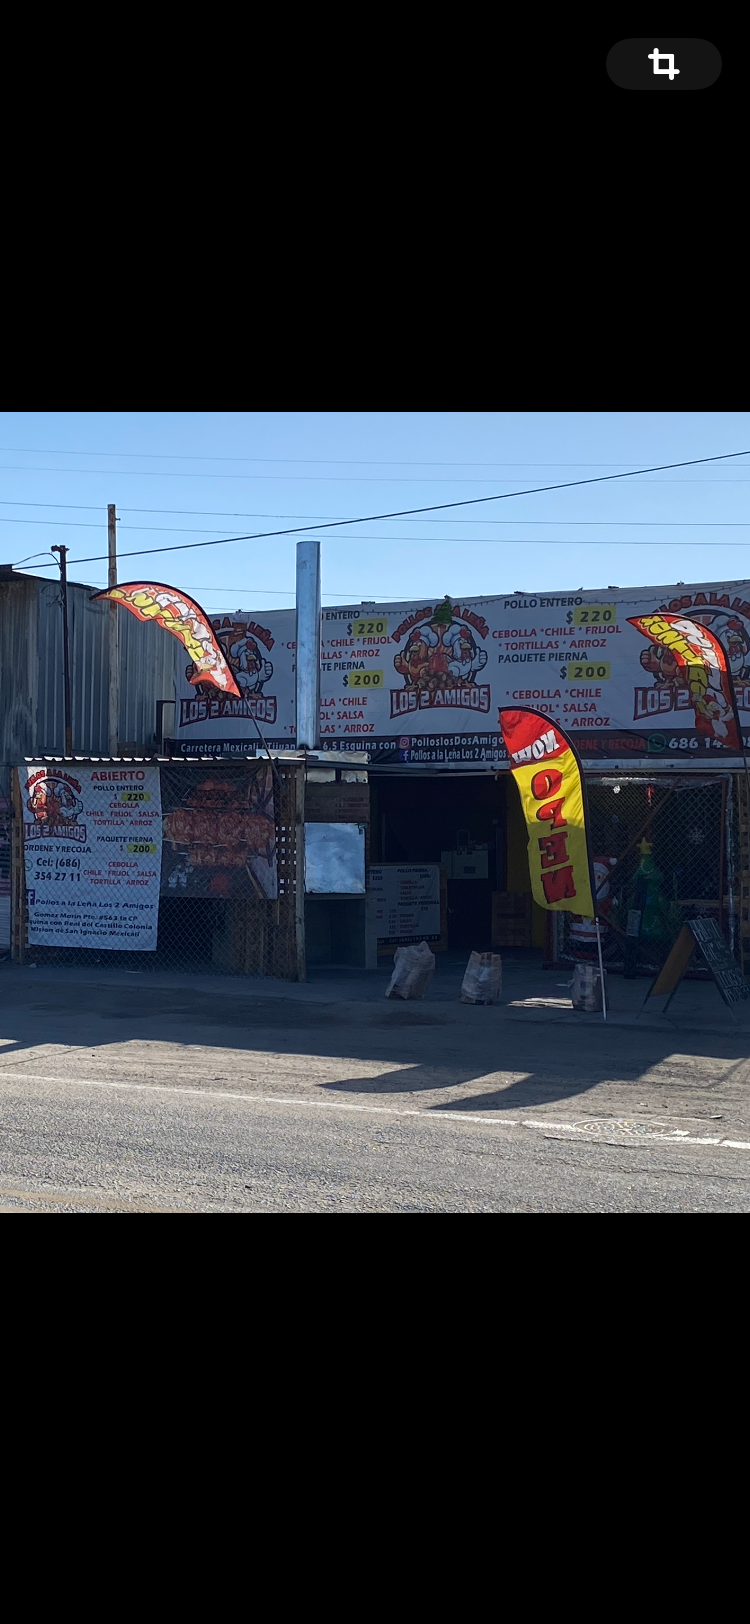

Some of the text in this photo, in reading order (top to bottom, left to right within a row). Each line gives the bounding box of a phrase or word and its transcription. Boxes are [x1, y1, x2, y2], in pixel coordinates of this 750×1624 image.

[504, 597, 583, 610] POLLO ENTERO
[326, 611, 360, 620] ENTERO
[566, 610, 612, 624] $ 220
[347, 622, 384, 636] $ 220
[391, 606, 432, 643] POLLOS
[492, 628, 537, 639] CEBOLLA
[585, 625, 622, 635] FRIJOL
[363, 637, 392, 646] FRIJOL
[504, 639, 607, 651] TORTILLAS ARROZ
[350, 649, 380, 658] ARROZ
[498, 652, 588, 663] PAQUETE PIERNA
[334, 661, 365, 671] PIERNA
[559, 666, 607, 680] $ 200
[343, 674, 381, 687] $ 200
[512, 689, 562, 700] CEBOLLA
[392, 687, 490, 714] LOS 2 AMIGOS
[637, 689, 690, 713] LOS 2
[182, 700, 275, 721] LOS 2 AMIGOS
[563, 703, 597, 713] SALSA
[337, 711, 364, 721] SALSA
[571, 717, 610, 727] ARROZ
[344, 723, 375, 733] ARROZ
[180, 743, 221, 753] Carretera
[222, 742, 259, 752] Mexicali
[323, 741, 397, 751] 6.5 Esquina con
[669, 737, 699, 750] 686
[411, 749, 430, 761] Pollos
[437, 749, 444, 760] la
[462, 748, 473, 759] Los
[480, 747, 506, 761] Amigos
[90, 770, 146, 781] ABIERTO
[127, 793, 145, 801] 220
[53, 825, 86, 842] AMIGOS
[61, 846, 92, 854] RECOJA
[133, 845, 150, 853] 200
[36, 858, 81, 870] Cel: (686)
[34, 871, 81, 882] 354 27 11
